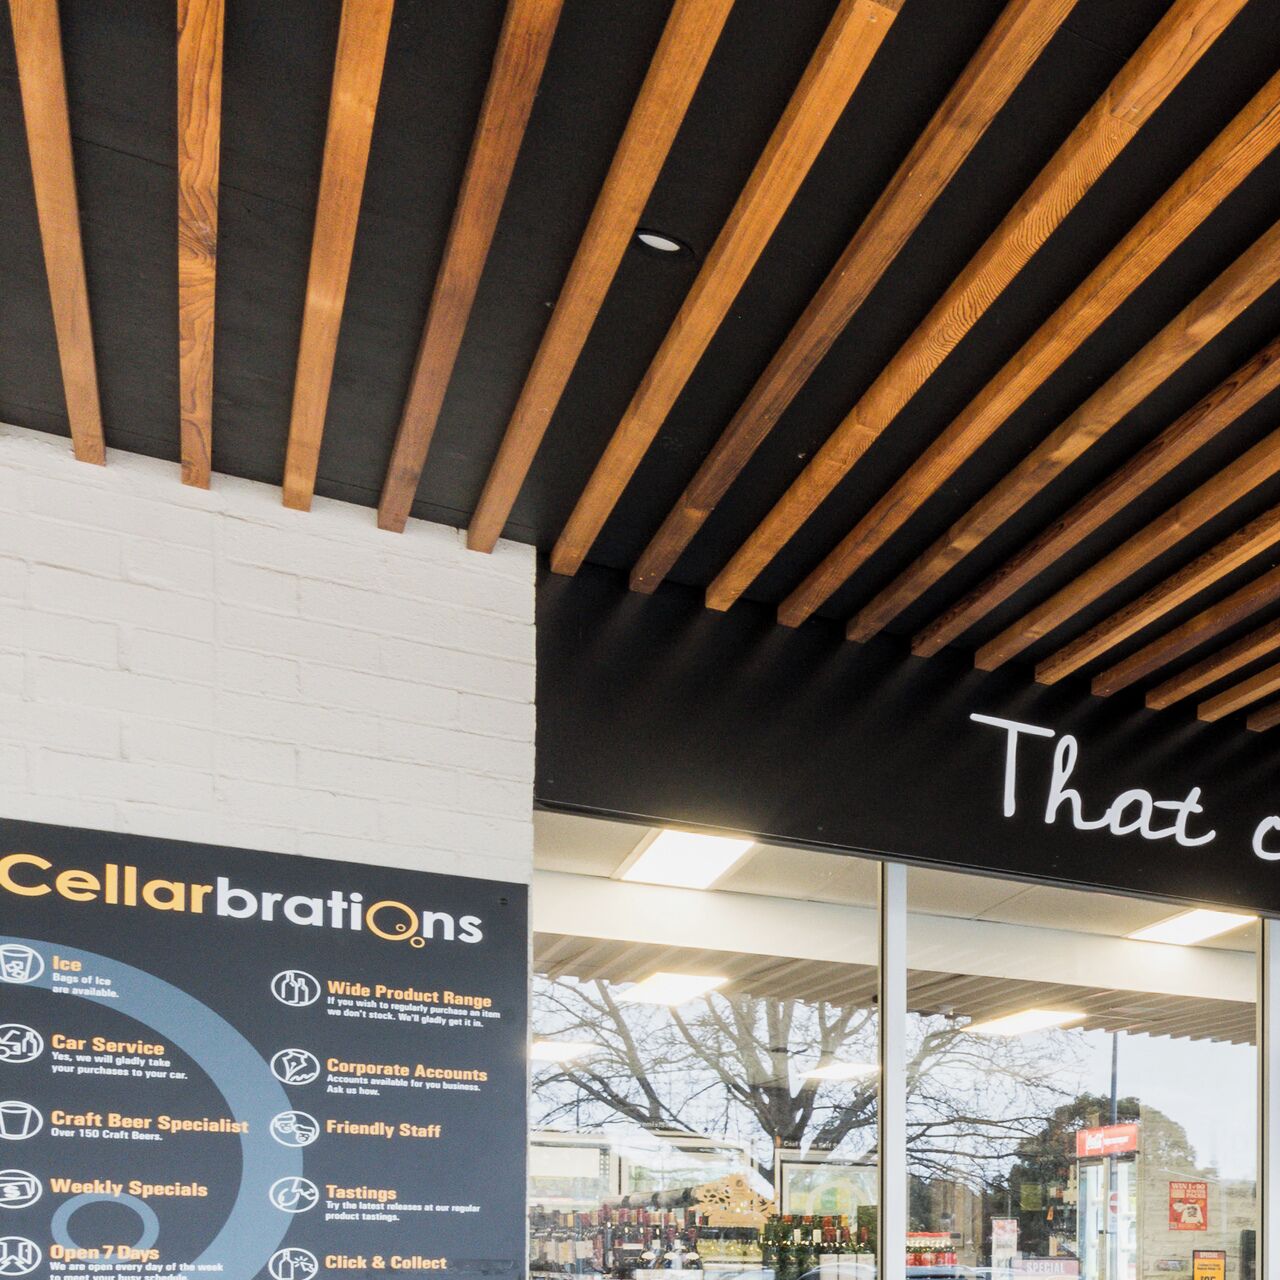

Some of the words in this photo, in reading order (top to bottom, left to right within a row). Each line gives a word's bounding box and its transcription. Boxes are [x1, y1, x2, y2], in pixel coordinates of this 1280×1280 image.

[970, 713, 1216, 847] That
[0, 853, 483, 946] Cellarbrations
[53, 956, 82, 971] Ice
[52, 973, 79, 984] Bags
[81, 976, 92, 984] of
[95, 976, 111, 985] Ice
[71, 987, 119, 997] available.
[328, 981, 370, 997] Wide
[375, 985, 439, 1003] Product
[444, 991, 491, 1008] Range
[327, 996, 335, 1004] If
[337, 999, 353, 1009] you
[356, 1000, 377, 1009] wish
[391, 1003, 428, 1013] regularly
[430, 1007, 468, 1015] purchase
[470, 1008, 481, 1016] an
[482, 1010, 500, 1018] item
[343, 1009, 366, 1018] don't
[369, 1012, 396, 1020] stock.
[398, 1013, 419, 1022] We'll
[421, 1015, 446, 1025] gladly
[473, 1019, 483, 1027] in.
[52, 1034, 86, 1053] Car
[92, 1037, 164, 1056] Service
[52, 1052, 72, 1061] Yes,
[94, 1055, 113, 1065] will
[115, 1056, 145, 1067] gladly
[149, 1058, 171, 1067] take
[52, 1065, 75, 1073] your
[77, 1067, 129, 1076] purchases
[327, 1058, 409, 1076] Corporate
[414, 1064, 487, 1081] Accounts
[327, 1075, 368, 1084] Accounts
[370, 1078, 408, 1087] available
[410, 1079, 423, 1087] for
[443, 1081, 480, 1091] business.
[327, 1085, 344, 1093] Ask
[359, 1086, 380, 1095] how.
[51, 1110, 102, 1127] Craft
[108, 1113, 152, 1129] Beer
[158, 1116, 249, 1133] Specialist
[327, 1120, 394, 1138] Friendly
[399, 1123, 441, 1138] Staff
[51, 1128, 75, 1137] Over
[79, 1129, 99, 1138] 150
[102, 1130, 129, 1139] Craft
[132, 1131, 163, 1140] Beers.
[50, 1178, 123, 1197] Weekly
[129, 1181, 208, 1198] Specials
[326, 1185, 398, 1203] Tastings
[326, 1201, 340, 1210] Try
[342, 1201, 357, 1209] the
[359, 1202, 385, 1210] latest
[387, 1202, 422, 1211] releases
[451, 1204, 480, 1213] regular
[325, 1212, 359, 1221] product
[362, 1213, 400, 1222] tastings.
[50, 1244, 100, 1263] Open
[103, 1245, 114, 1260] 7
[117, 1245, 159, 1262] Days
[50, 1262, 66, 1270] We
[88, 1262, 113, 1272] open
[115, 1264, 143, 1272] every
[145, 1263, 163, 1272] day
[165, 1263, 176, 1271] of
[179, 1263, 196, 1271] the
[197, 1263, 223, 1271] week
[325, 1255, 367, 1269] Click
[371, 1256, 385, 1269] &
[391, 1256, 447, 1269] Collect
[1026, 1262, 1065, 1273] SPECIAL
